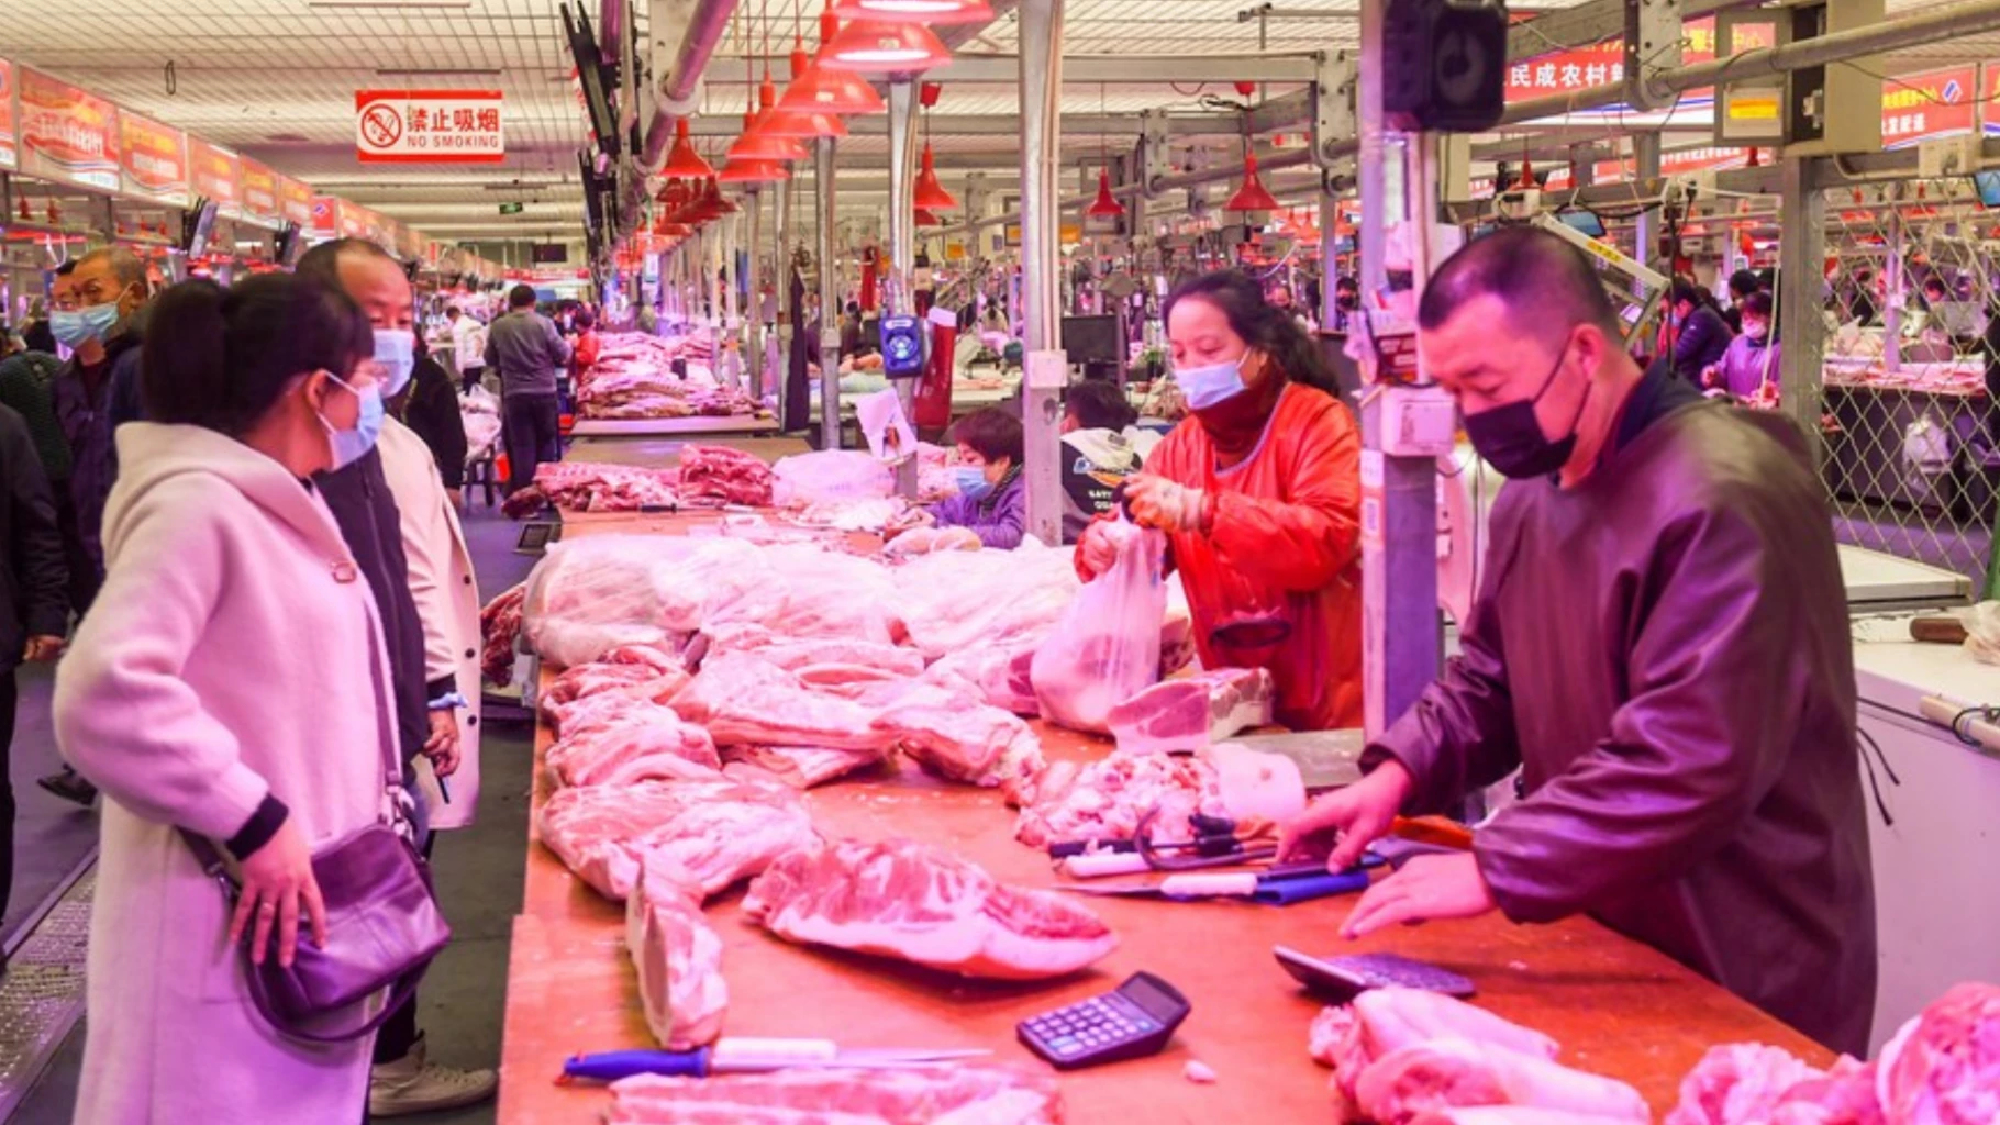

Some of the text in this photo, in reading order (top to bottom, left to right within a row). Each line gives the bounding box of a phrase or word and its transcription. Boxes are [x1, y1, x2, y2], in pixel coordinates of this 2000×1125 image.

[407, 107, 499, 132] 禁止吸烟
[408, 135, 498, 147] NO SMOKING
